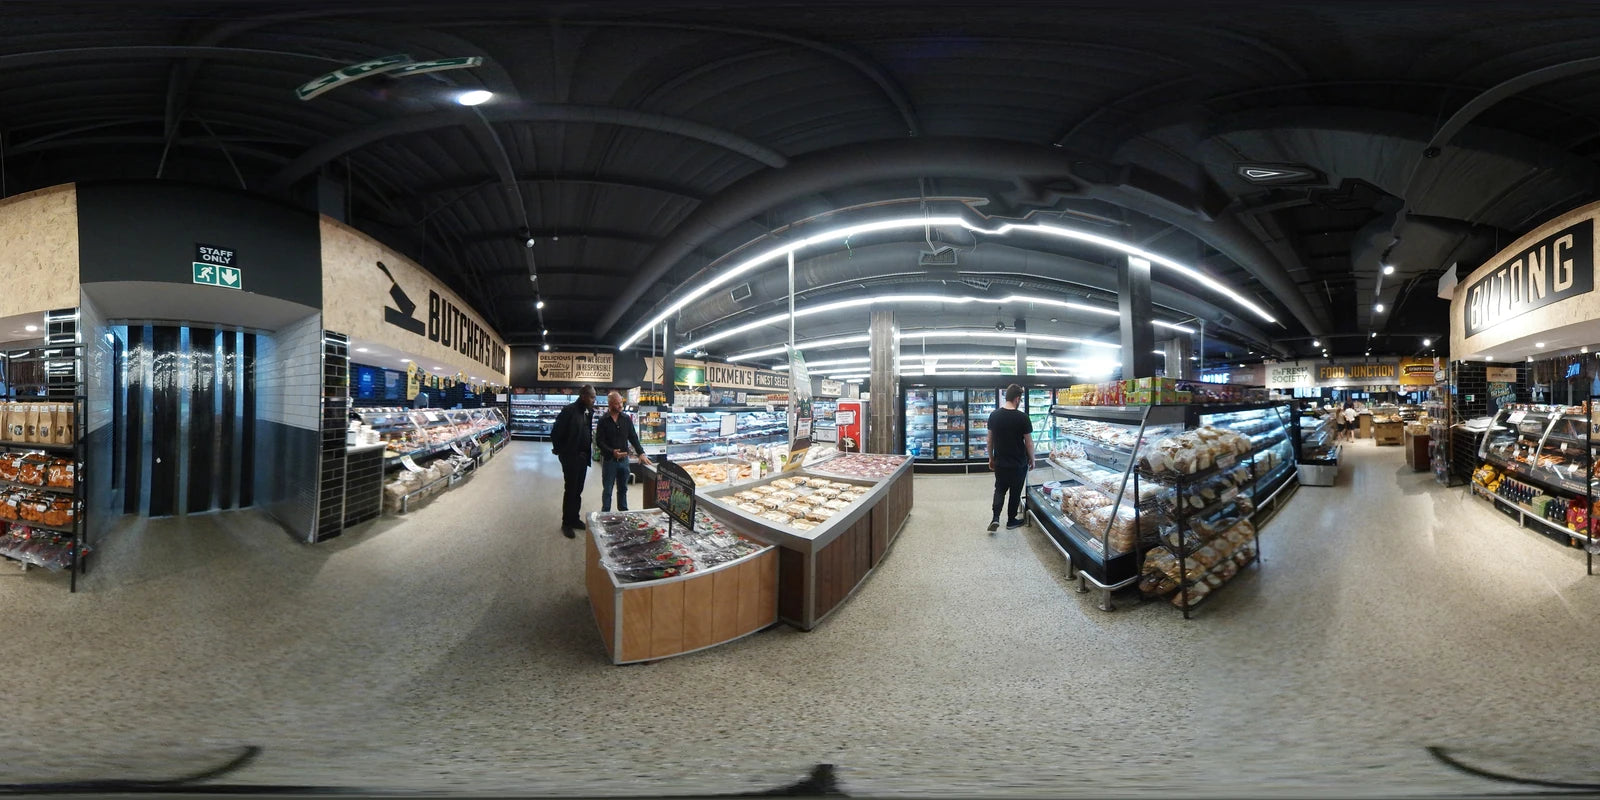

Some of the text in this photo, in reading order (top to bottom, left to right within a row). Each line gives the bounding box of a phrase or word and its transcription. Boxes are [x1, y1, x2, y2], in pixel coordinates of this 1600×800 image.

[200, 247, 233, 257] STAFF
[202, 254, 230, 264] ONLY
[428, 289, 490, 367] BUTCHER'S
[582, 364, 611, 372] RESPONSIBLE
[1281, 367, 1308, 375] FRESH
[1320, 365, 1394, 379] FOOD JUNCTION
[549, 371, 571, 379] PRODUCTS
[704, 366, 752, 386] LOCKMEN'S
[756, 374, 773, 386] FINEST
[1272, 375, 1308, 383] SOCIETY
